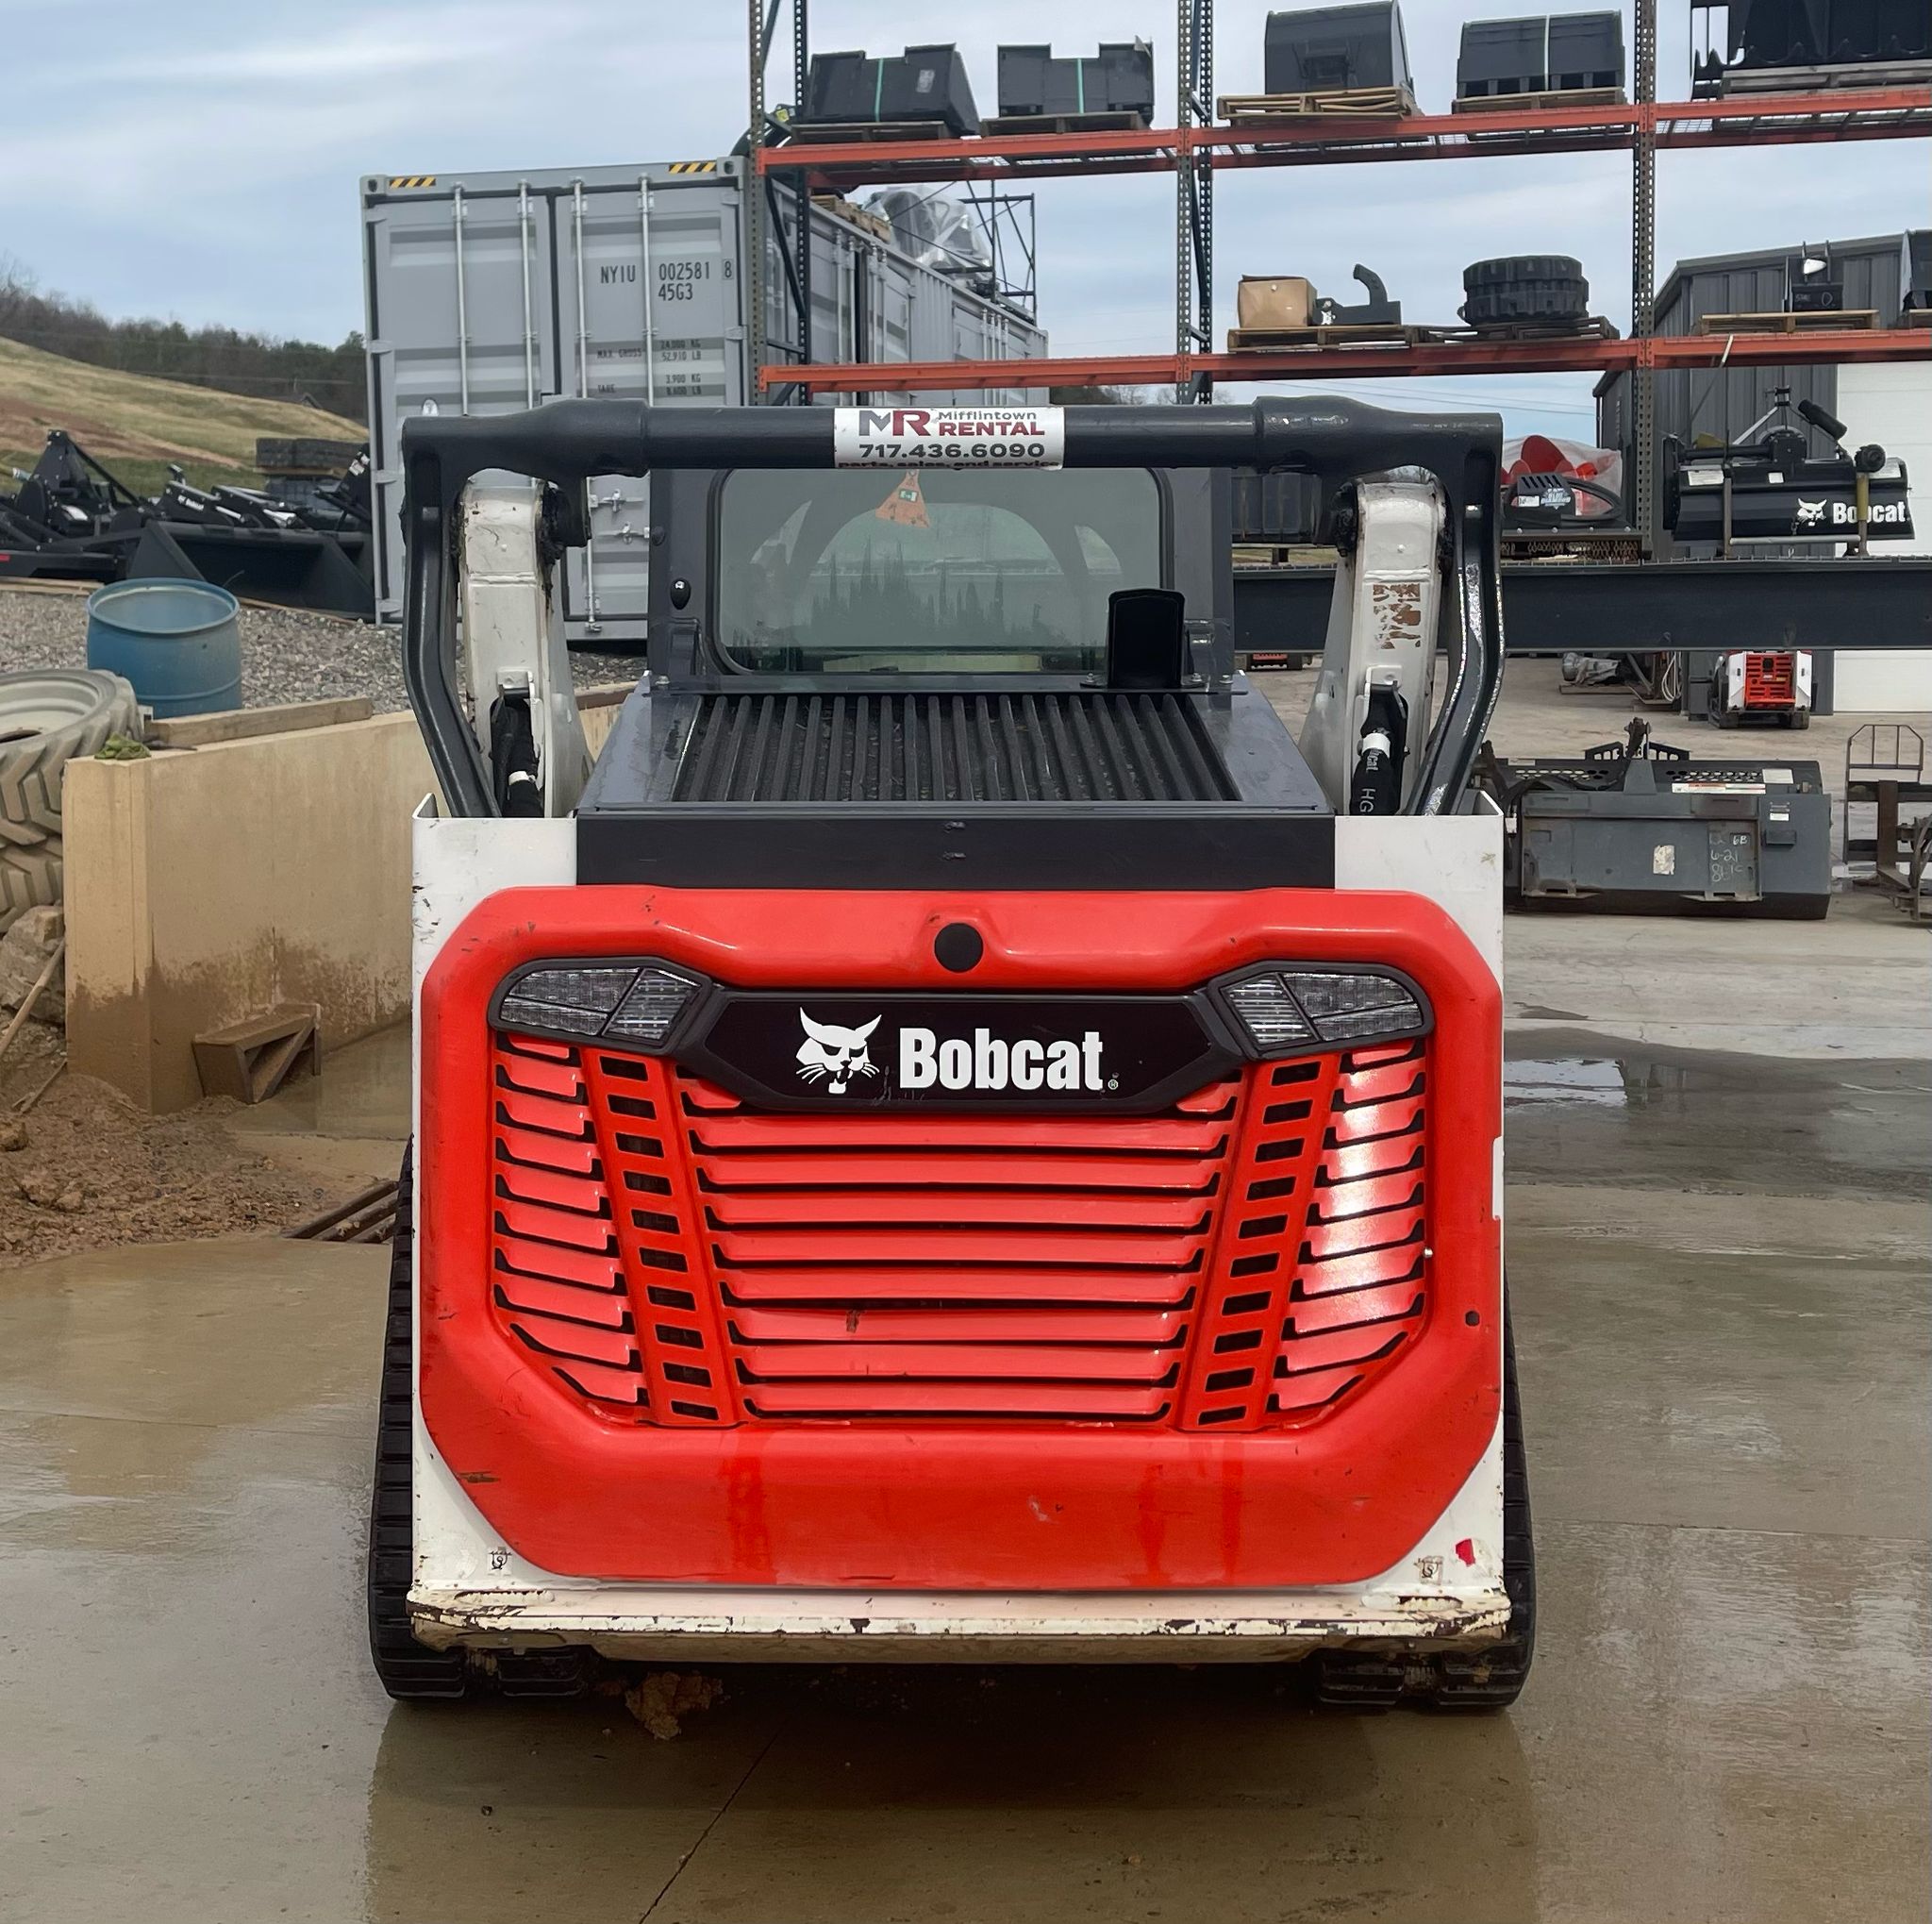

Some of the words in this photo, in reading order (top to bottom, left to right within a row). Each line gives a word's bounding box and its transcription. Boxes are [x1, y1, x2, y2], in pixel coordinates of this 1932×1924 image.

[601, 265, 636, 284] NYIU
[658, 261, 709, 281] 002581
[724, 260, 732, 278] 8
[658, 283, 693, 301] 45G3
[858, 410, 931, 437] MR
[938, 410, 1037, 421] Mifflintown
[938, 422, 1046, 436] RENTAL
[858, 443, 1045, 459] 717.436.6090
[1832, 501, 1906, 525] Bocat
[899, 1028, 1104, 1091] Bobcat
